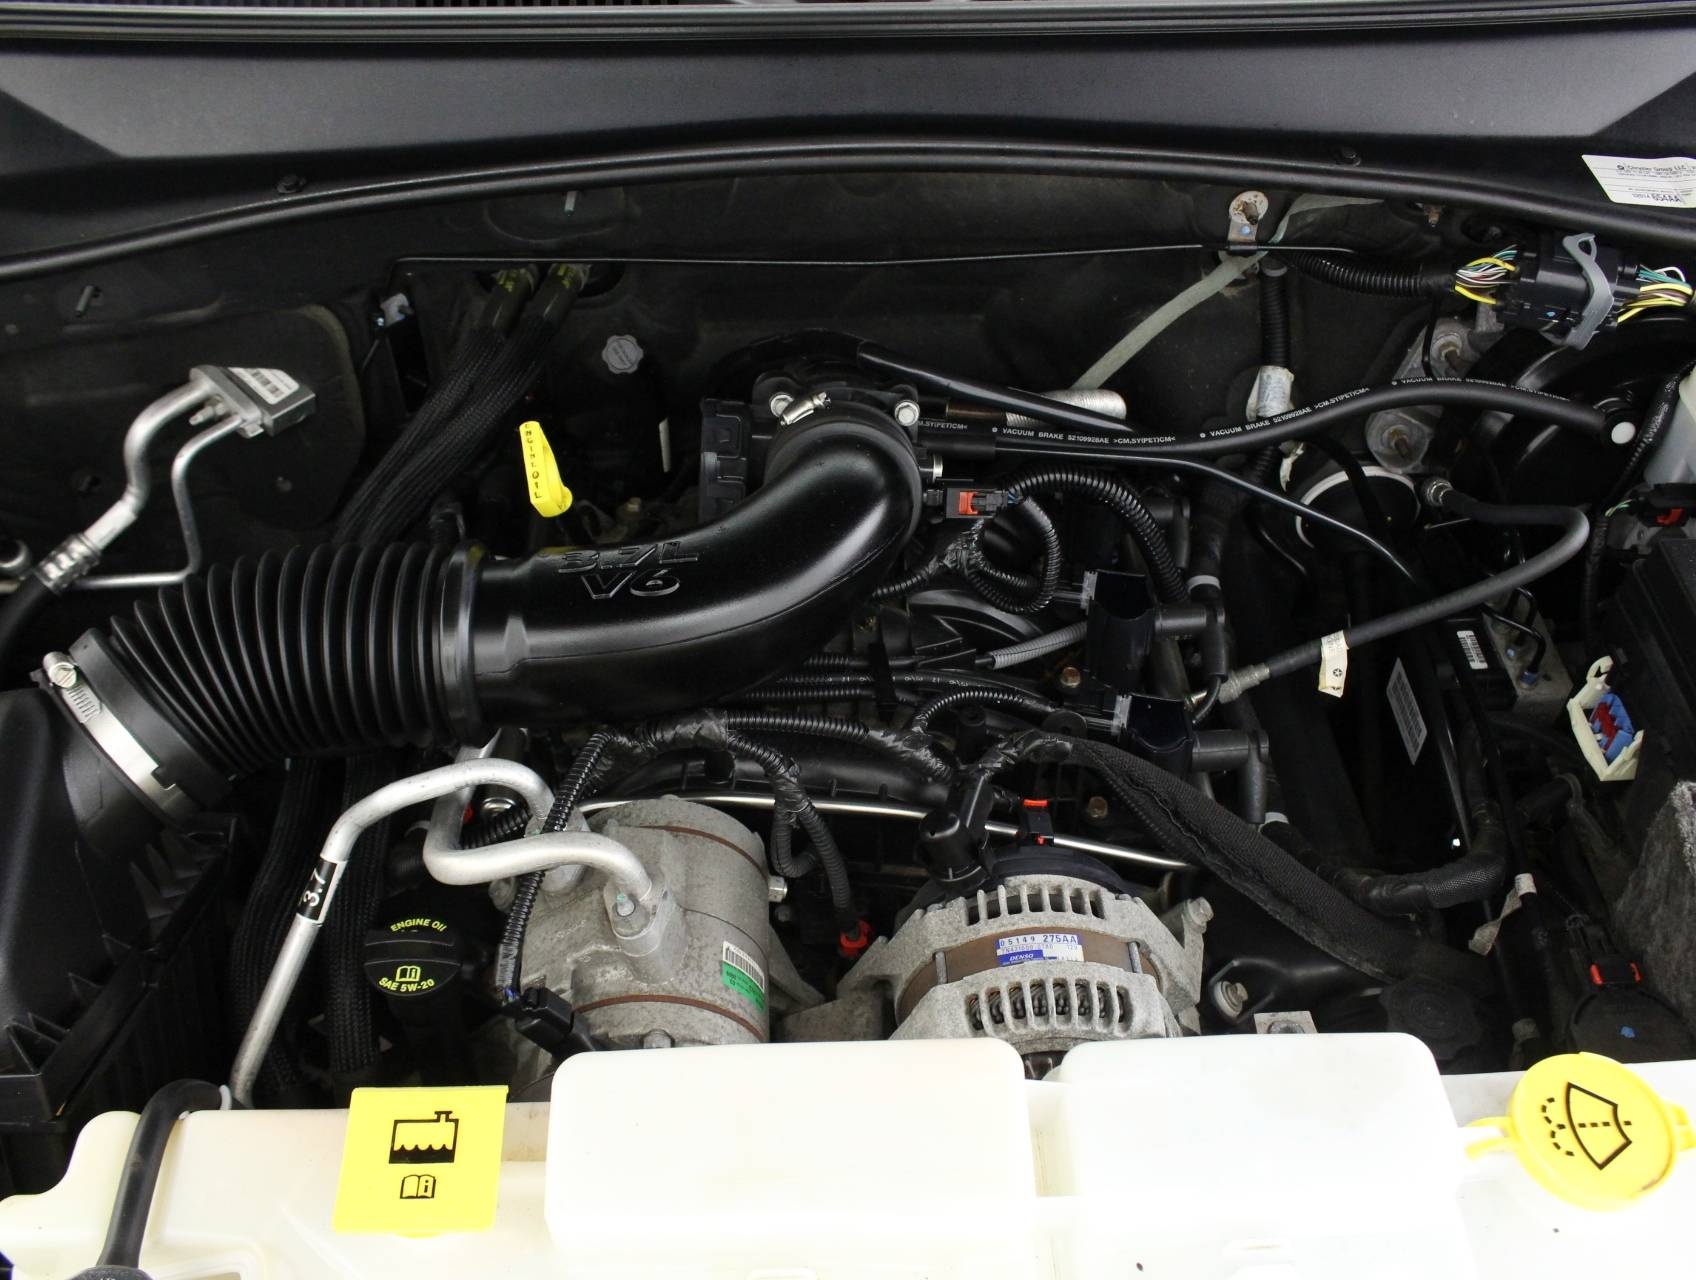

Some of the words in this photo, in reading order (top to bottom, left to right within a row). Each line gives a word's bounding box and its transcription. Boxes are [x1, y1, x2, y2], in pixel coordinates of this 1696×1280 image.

[1002, 427, 1034, 437] VACUUM
[1038, 431, 1064, 440] BRAKE
[1209, 426, 1242, 437] VACUUM
[1245, 420, 1271, 431] BRAKE
[558, 540, 699, 573] 3.7L
[580, 568, 681, 600] V6
[303, 868, 326, 907] 3.7
[390, 918, 431, 932] ENGINE
[1042, 934, 1077, 944] 275AA
[1009, 953, 1034, 961] DENSO
[379, 977, 399, 991] SAE
[400, 978, 435, 992] 5W-20
